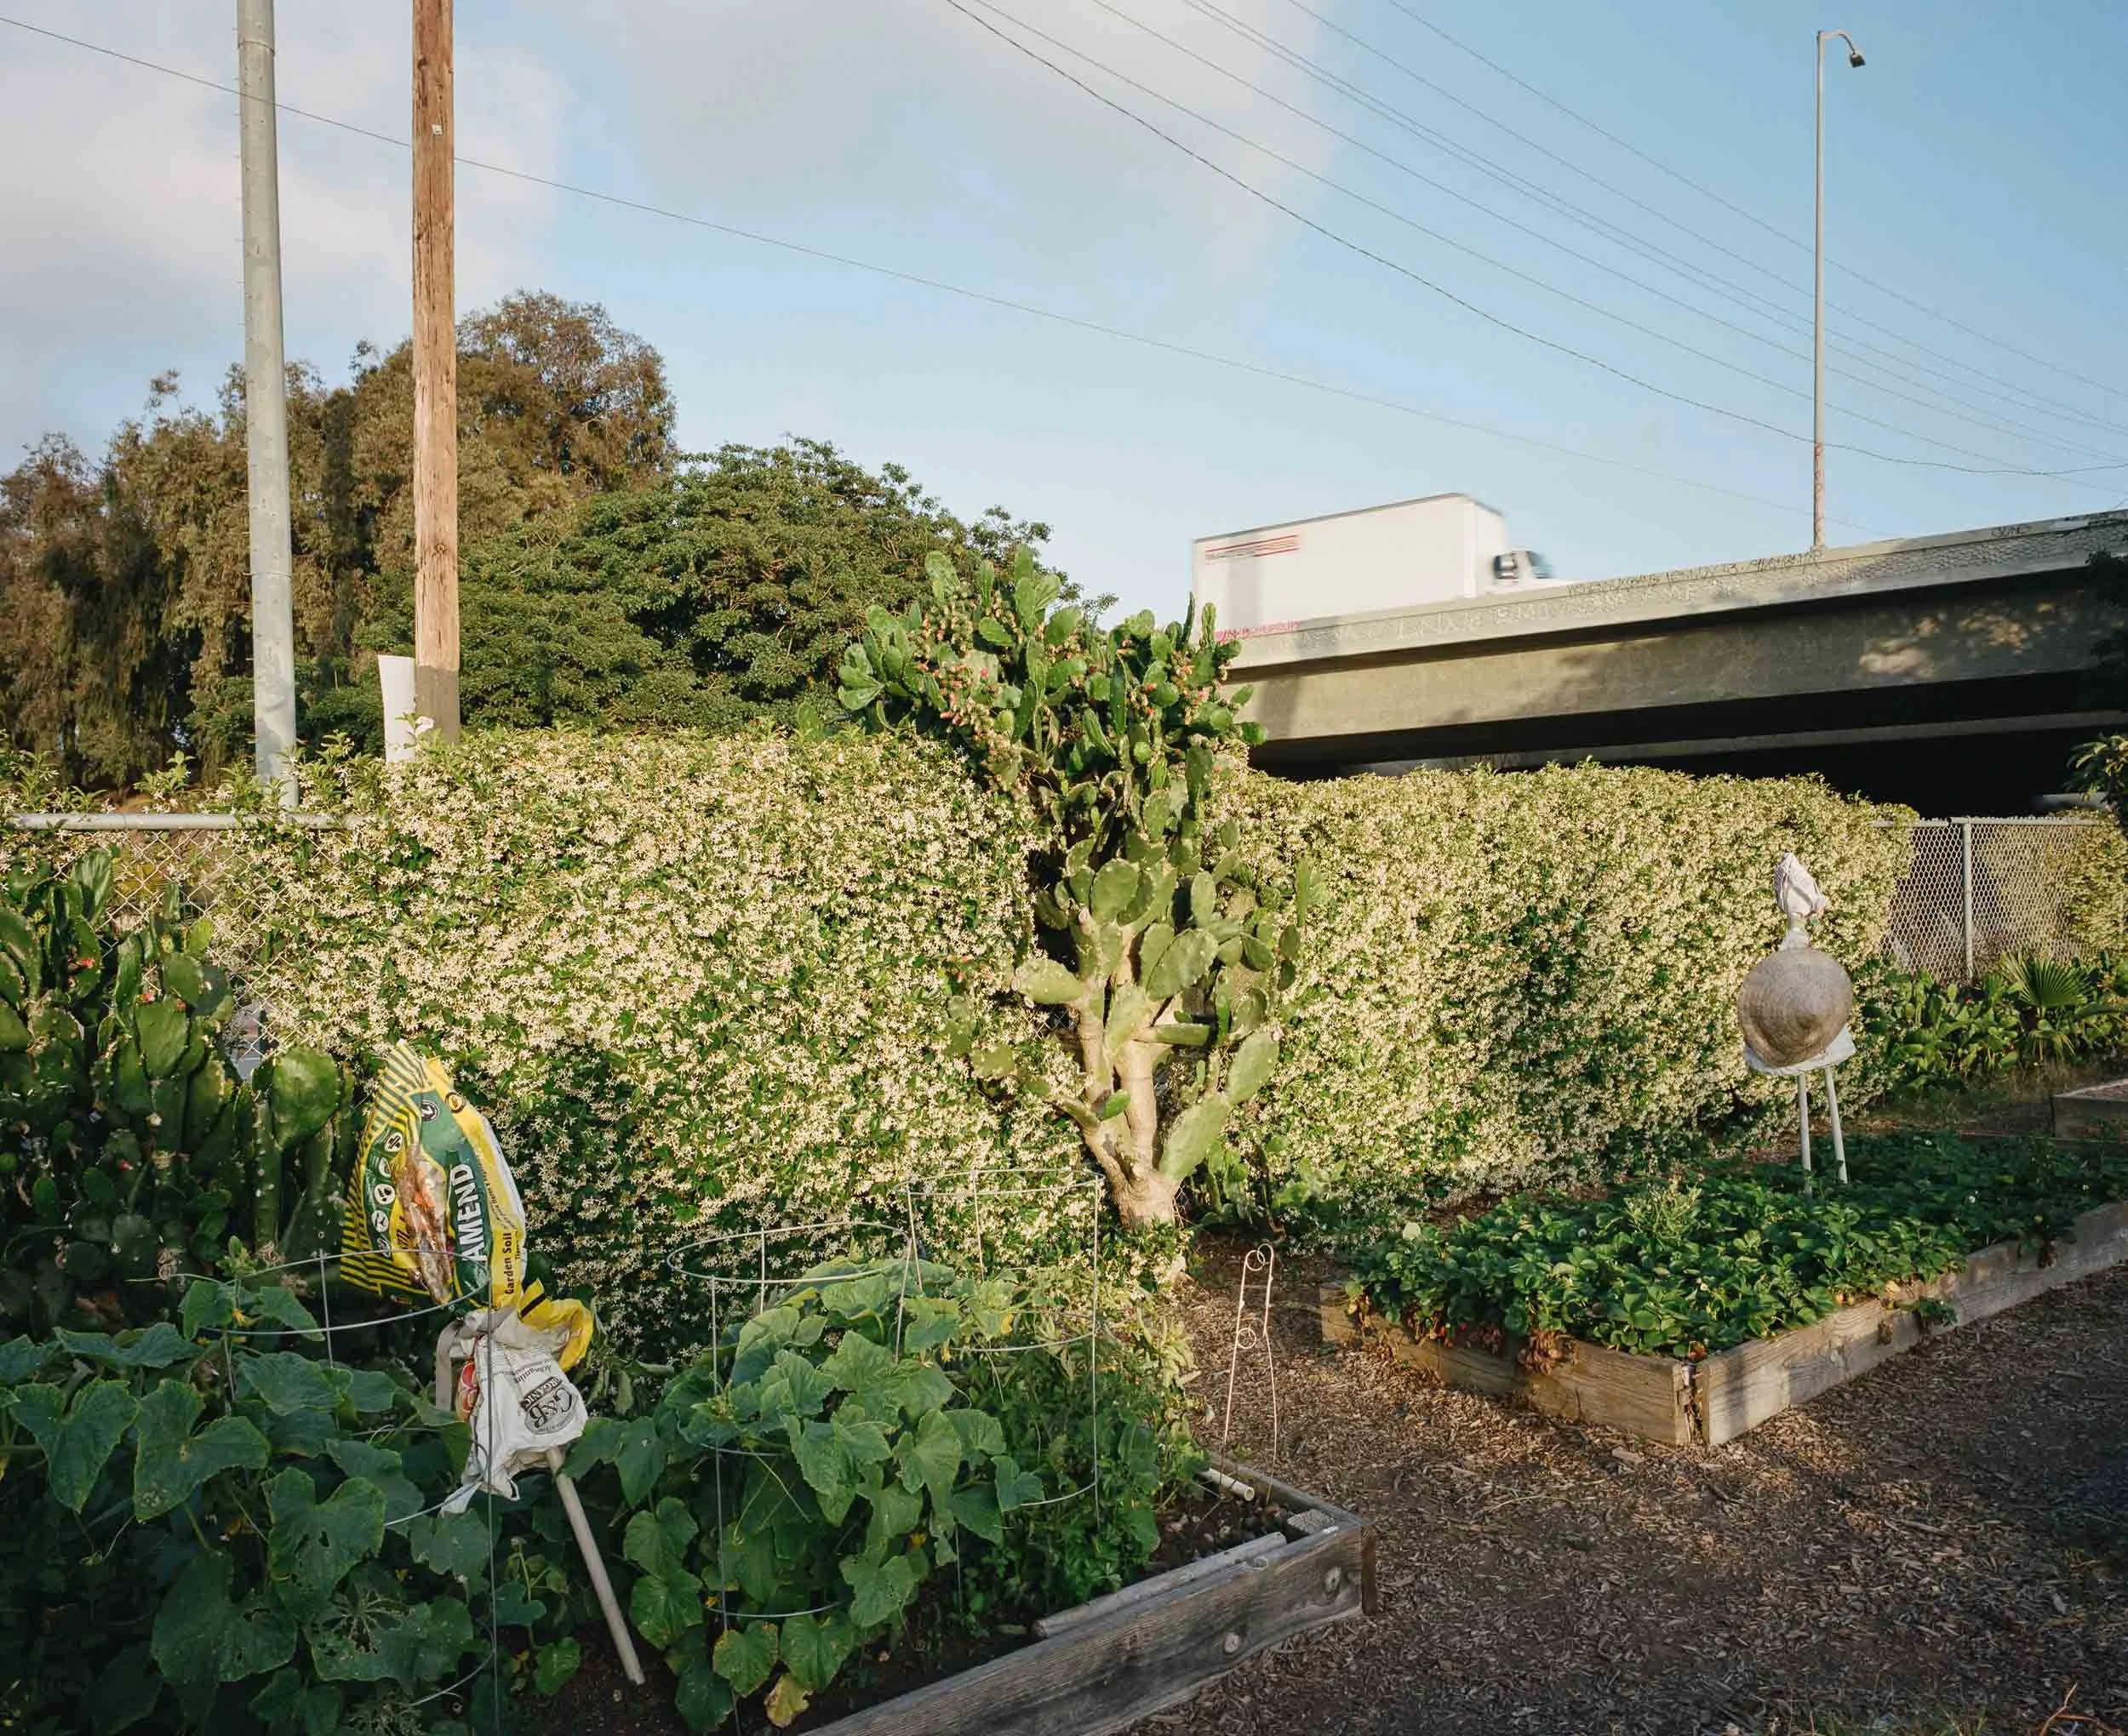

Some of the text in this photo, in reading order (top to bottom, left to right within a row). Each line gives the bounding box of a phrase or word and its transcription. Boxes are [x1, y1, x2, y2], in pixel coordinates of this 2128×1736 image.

[451, 1162, 488, 1263] AMEND
[502, 1232, 515, 1294] Garden Soil
[529, 1387, 573, 1429] G&B
